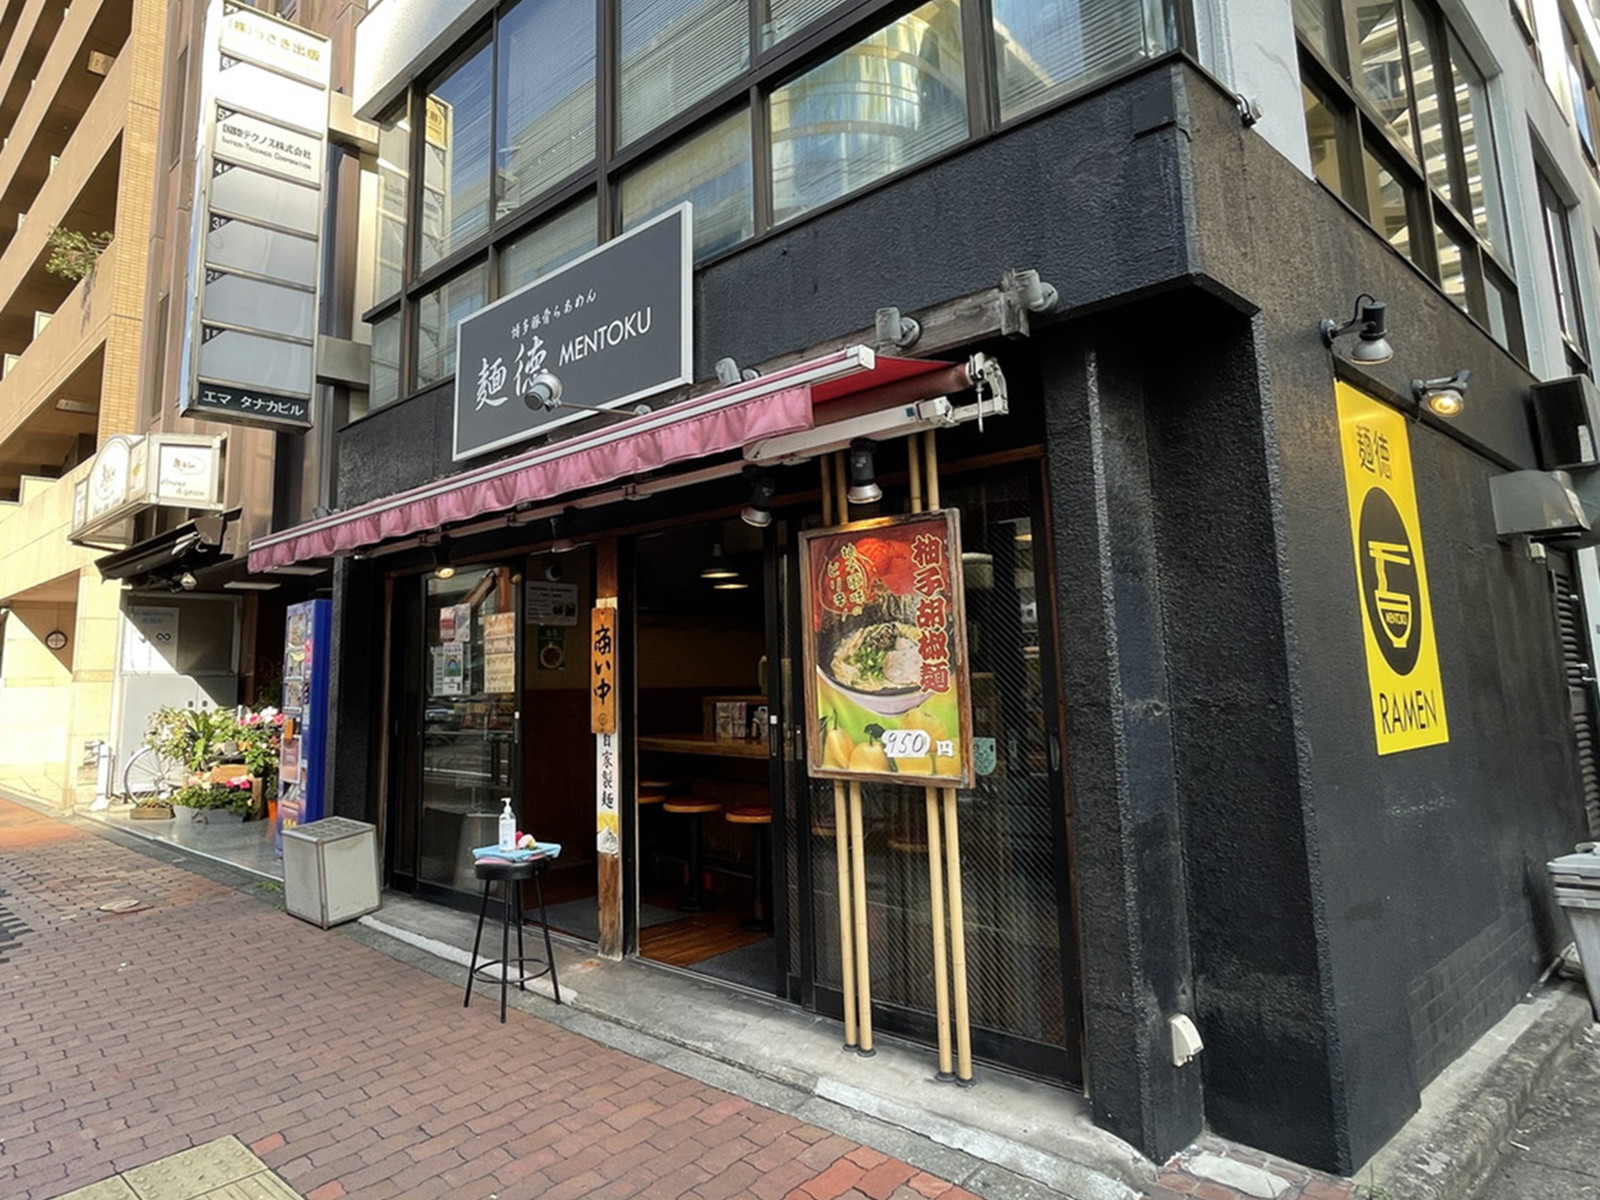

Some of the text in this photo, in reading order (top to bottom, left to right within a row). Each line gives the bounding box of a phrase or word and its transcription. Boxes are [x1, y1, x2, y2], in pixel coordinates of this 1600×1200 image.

[558, 306, 652, 367] MENTOKU
[202, 390, 305, 417] エマ タナカビル
[593, 624, 613, 705] 商い中
[1379, 689, 1438, 736] RAMEN
[888, 732, 925, 754] 950
